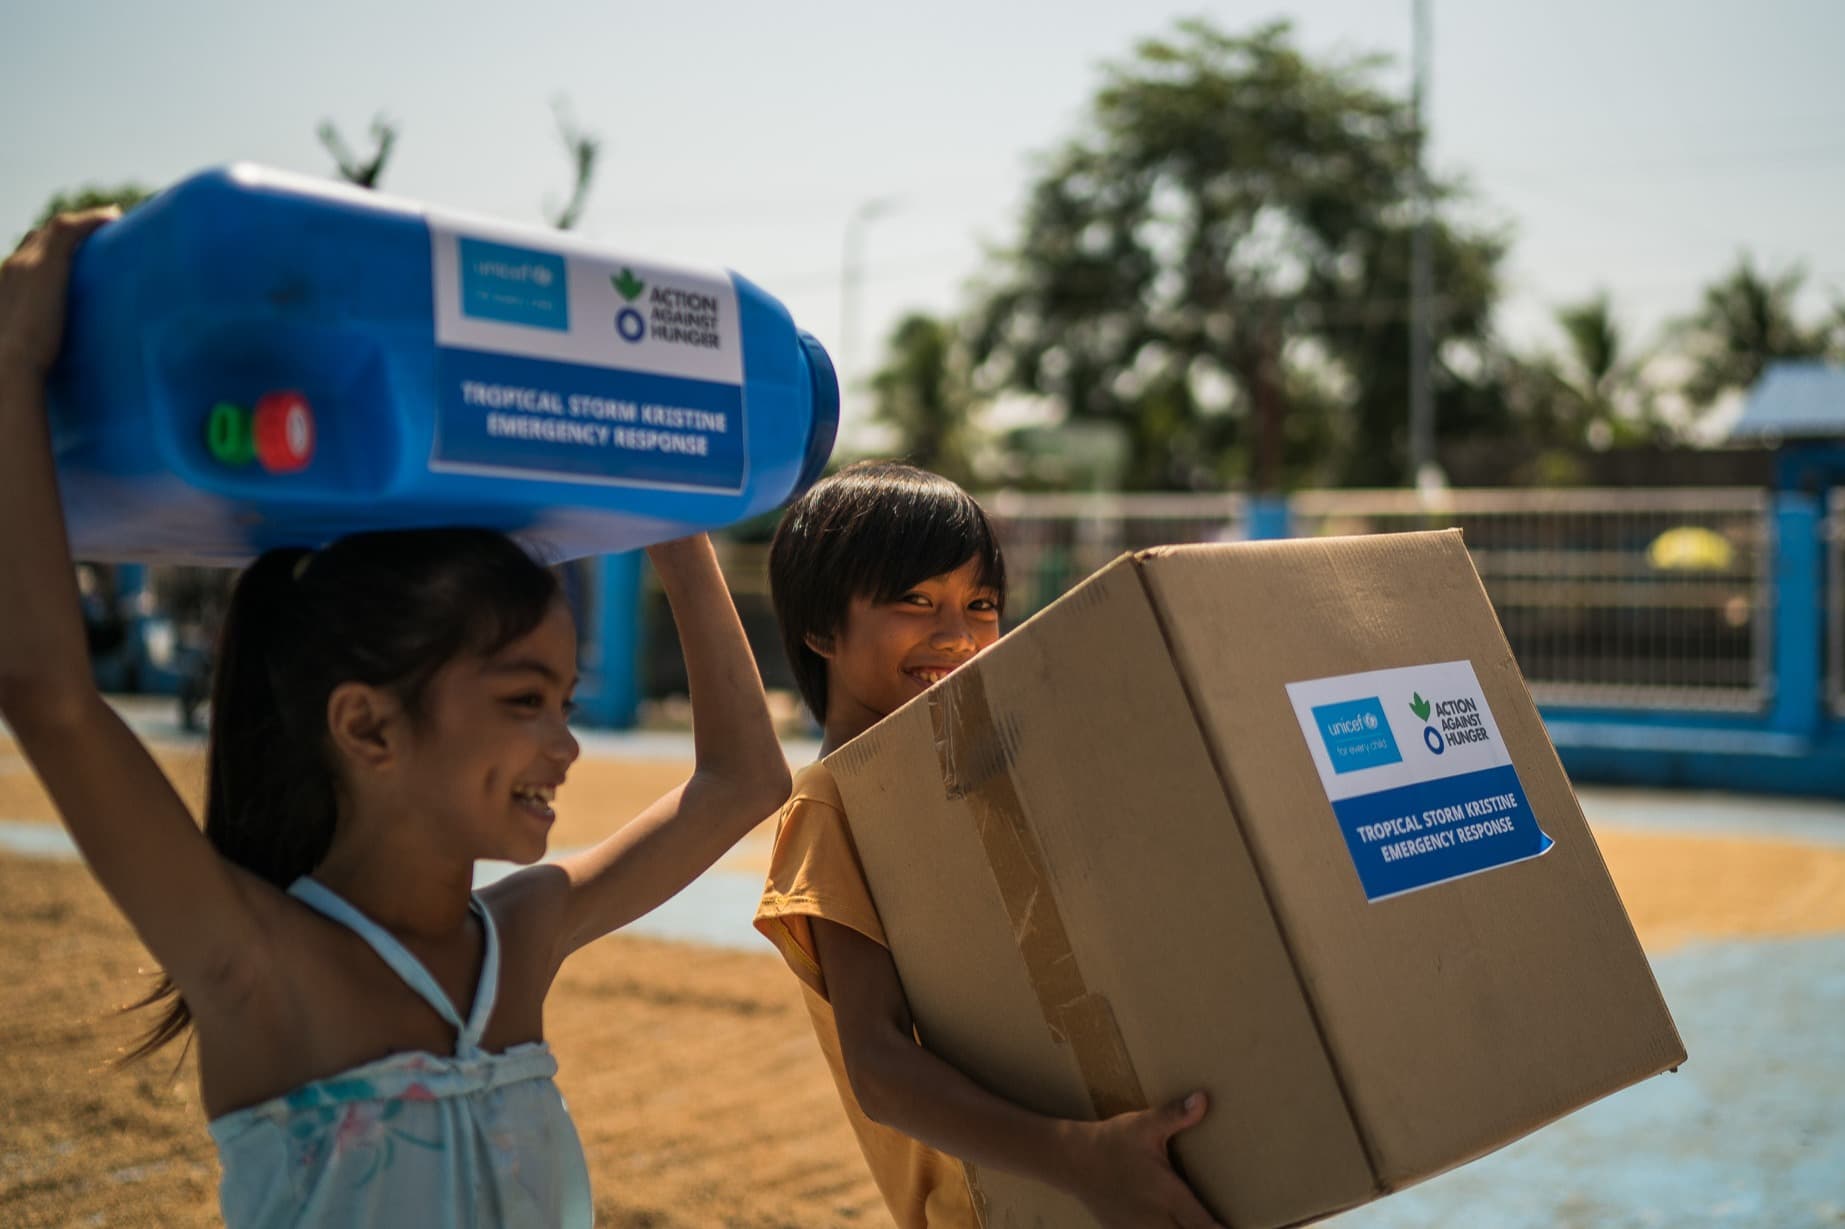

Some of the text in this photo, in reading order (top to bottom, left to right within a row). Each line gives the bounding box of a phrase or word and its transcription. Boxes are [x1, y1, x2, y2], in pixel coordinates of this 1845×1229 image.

[651, 287, 718, 312] ACTION
[652, 308, 719, 330] AGAINST
[652, 326, 719, 349] HUNGER
[462, 383, 727, 432] TROPICAL STORM KRISTINE
[487, 413, 708, 456] EMERGENCY RESPONSE
[1436, 698, 1477, 717] ACTION
[1328, 714, 1364, 736] unicef
[1441, 713, 1482, 731] AGAINST
[1336, 738, 1387, 756] for every child
[1445, 728, 1489, 746] HUNGER
[1356, 793, 1517, 843] TROPICAL STORM KRISTINE
[1381, 816, 1514, 862] EMERGENCY RESPONSE
